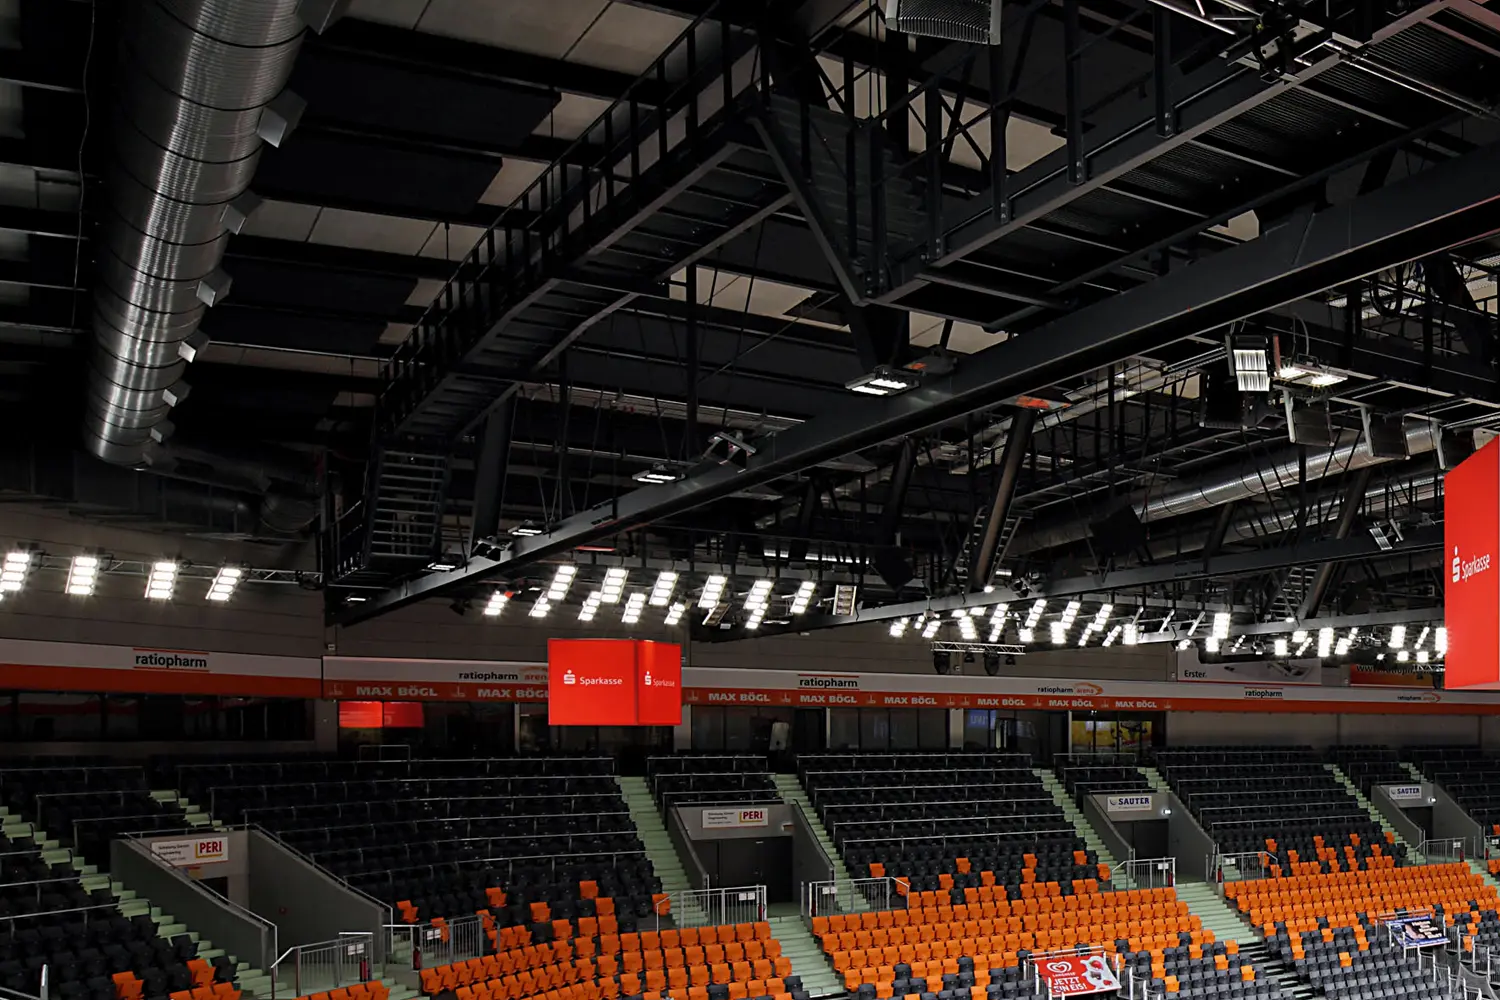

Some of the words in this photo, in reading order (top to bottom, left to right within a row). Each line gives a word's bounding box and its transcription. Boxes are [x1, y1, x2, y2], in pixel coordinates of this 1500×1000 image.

[1461, 552, 1490, 582] Sparkasse
[135, 653, 207, 669] ratiopharm
[459, 671, 518, 682] ratiopharm
[1184, 669, 1207, 679] Erster.
[579, 676, 623, 689] Sparkasse
[799, 676, 858, 689] ratiopharm
[356, 685, 392, 697] MAX
[397, 684, 438, 697] BÖGL
[477, 688, 511, 699] MAX
[1037, 686, 1074, 695] ratiopharm
[1244, 689, 1284, 699] ratiopharm
[707, 692, 736, 702] MAX
[739, 691, 769, 703] BÖGL
[799, 694, 825, 704] MAX
[828, 693, 858, 705] BÖGL
[884, 696, 908, 705] MAX
[910, 695, 938, 705] BÖGL
[977, 697, 999, 706] MAX
[1001, 696, 1026, 707] BÖGL
[1048, 699, 1070, 707] MAX
[1071, 698, 1094, 708] BÖGL
[1115, 700, 1135, 708] MAX
[1136, 699, 1158, 709] BÖGL
[1118, 797, 1150, 806] SAUTER
[742, 810, 763, 820] PERI
[200, 840, 223, 854] PERI
[1053, 976, 1080, 986] JETZT
